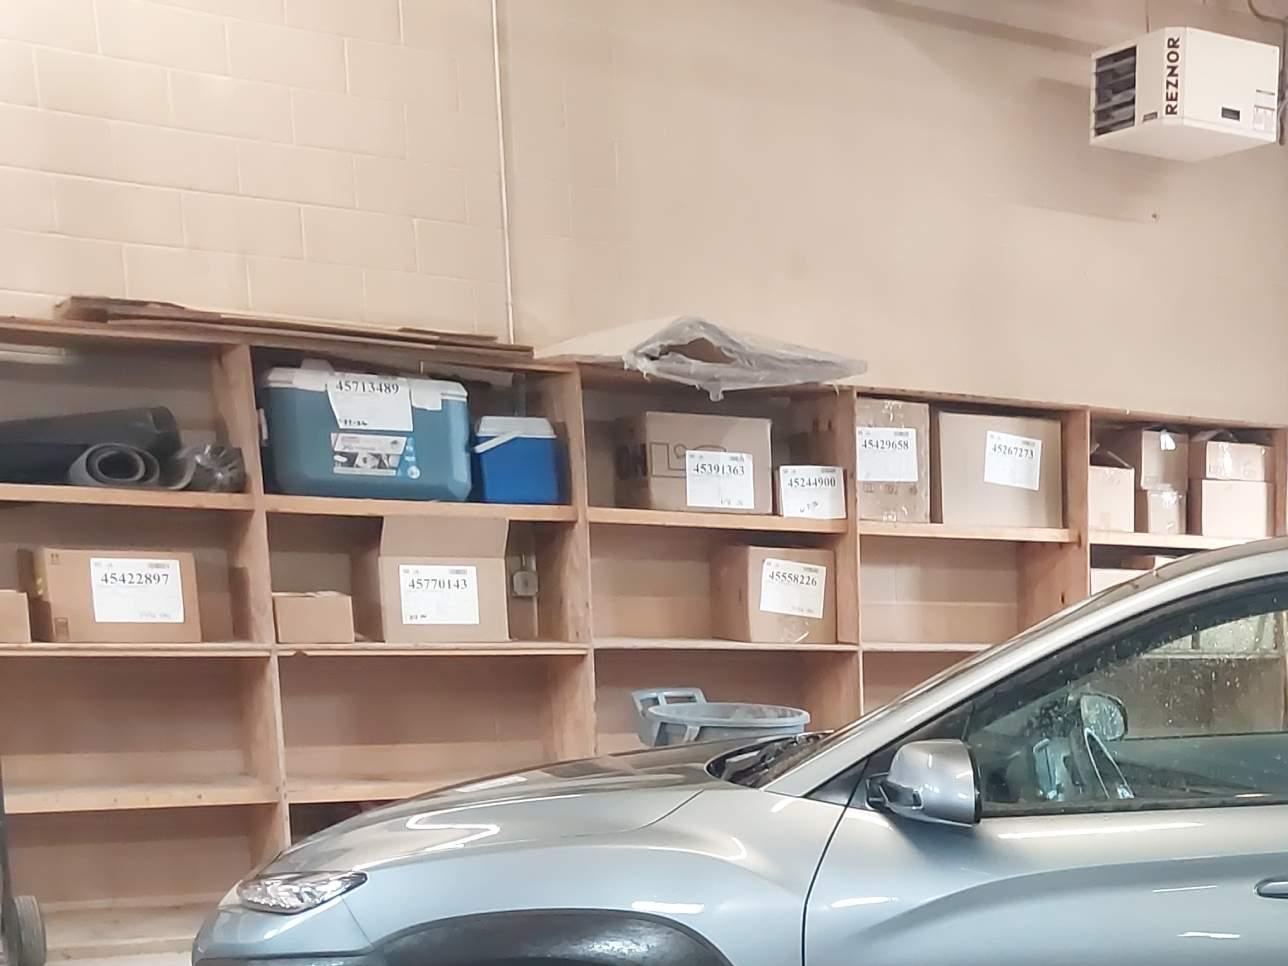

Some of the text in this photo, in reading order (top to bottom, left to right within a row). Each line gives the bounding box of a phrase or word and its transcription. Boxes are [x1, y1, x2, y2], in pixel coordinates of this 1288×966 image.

[1165, 36, 1181, 116] REZNOR
[336, 380, 400, 394] 45713489
[861, 439, 910, 450] 45429658
[692, 462, 745, 476] 45391363
[787, 476, 837, 489] 45244900
[100, 572, 169, 585] 45422897
[408, 578, 468, 590] 45770143
[768, 571, 818, 587] 45558226
